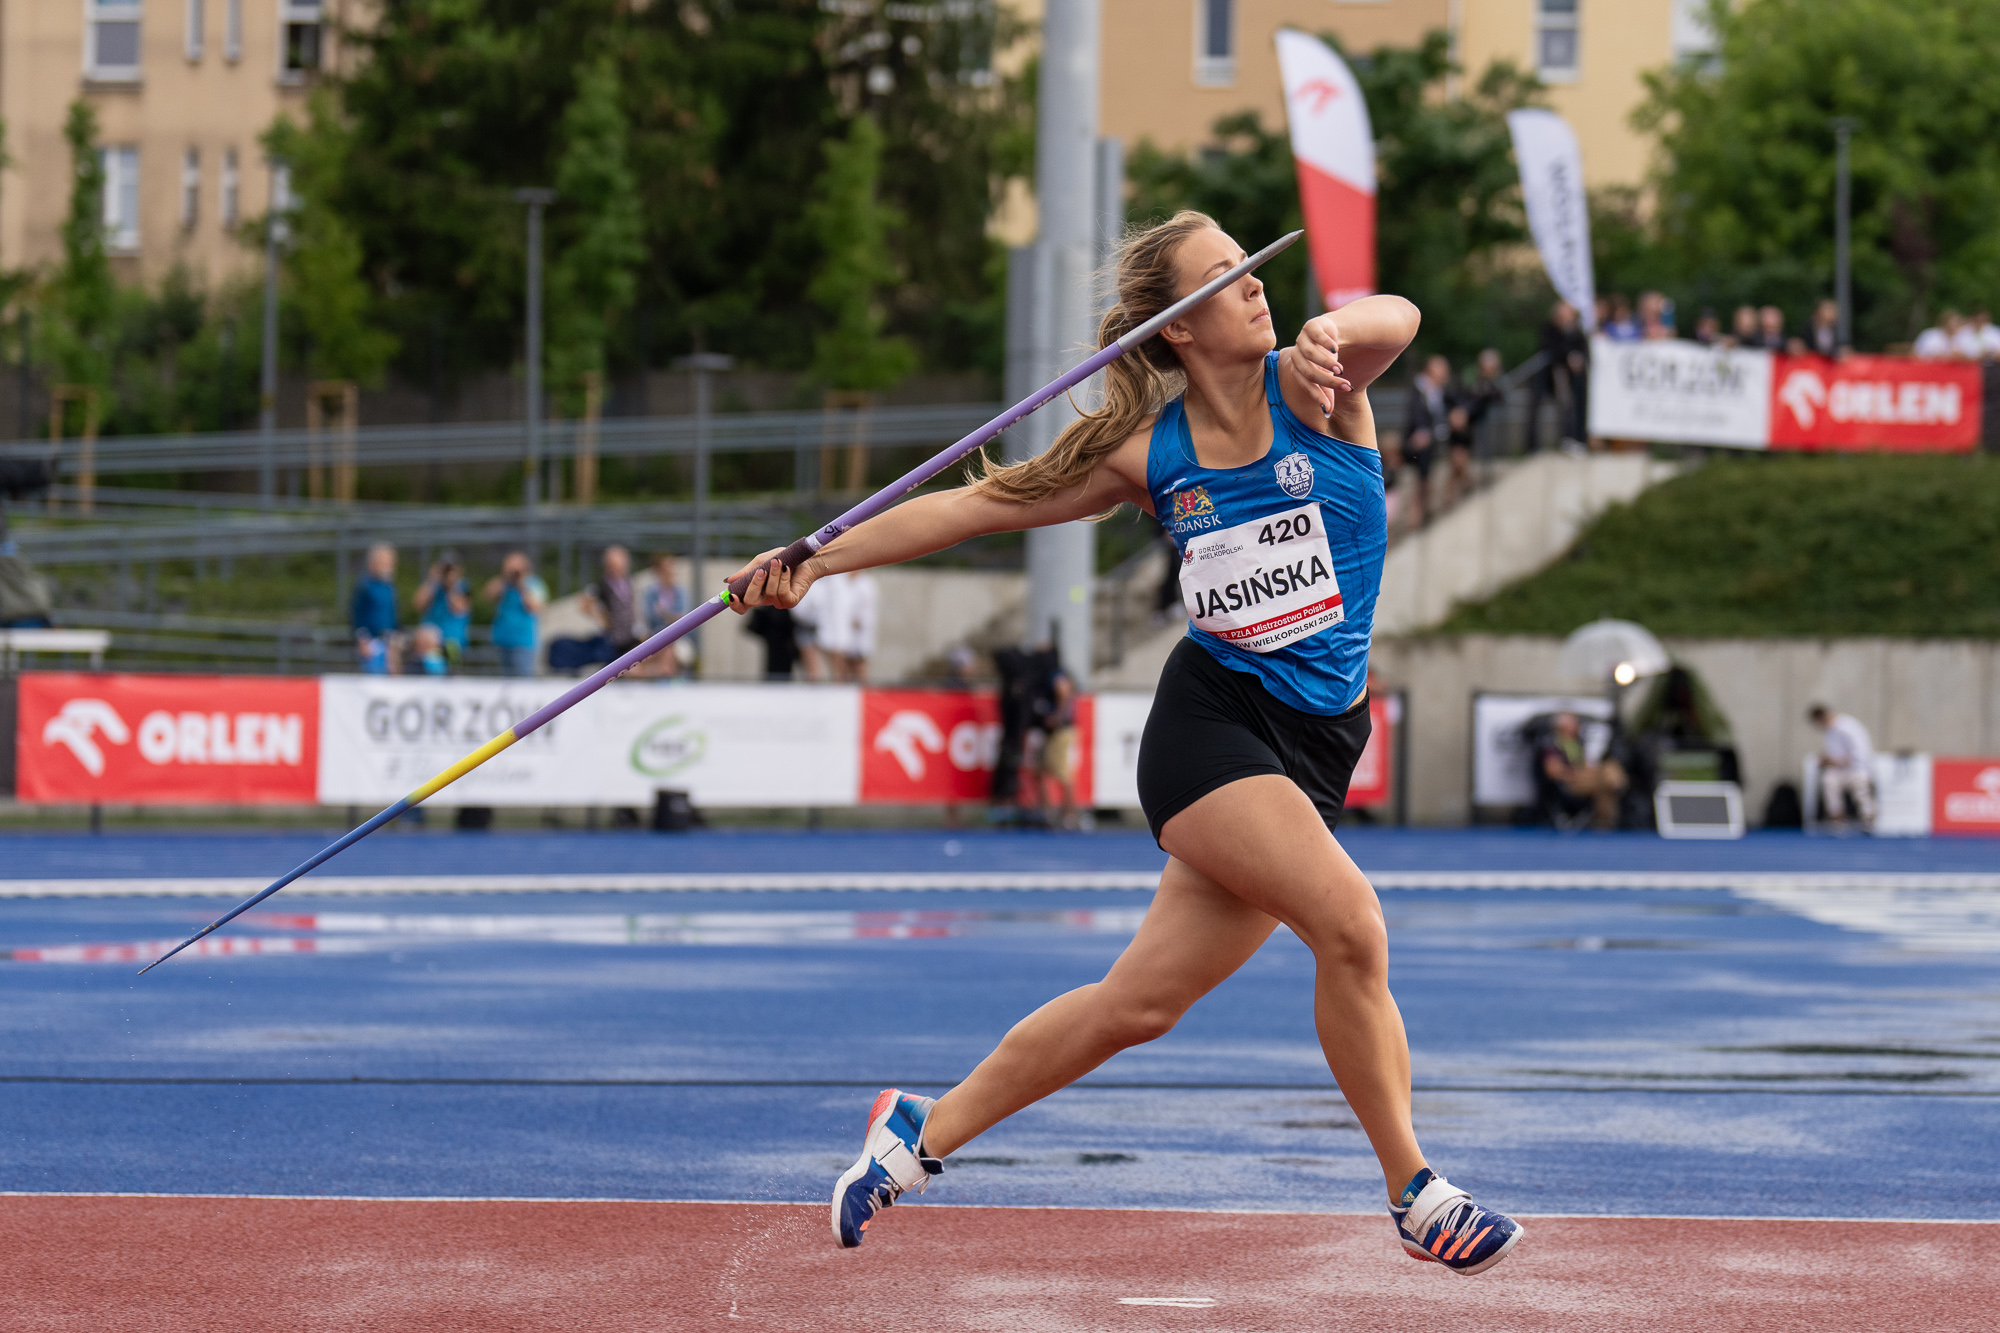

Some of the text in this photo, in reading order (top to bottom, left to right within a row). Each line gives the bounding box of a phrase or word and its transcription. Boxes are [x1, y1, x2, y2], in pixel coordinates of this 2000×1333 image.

[1828, 379, 1962, 424] ORLEN
[1285, 471, 1310, 487] AZS
[1174, 514, 1222, 533] GDAŃSK
[1258, 513, 1311, 546] 420
[1198, 543, 1226, 554] GORZÓW
[1199, 545, 1244, 560] WIELKOPOLSKI
[1195, 555, 1330, 619] JASIŃSKA
[1231, 630, 1251, 639] PZLA
[1252, 613, 1303, 634] Mistrzostwa
[1303, 602, 1326, 617] Polski
[1252, 620, 1318, 648] WIELKOPOLSKI
[1318, 611, 1339, 625] 2023
[137, 709, 301, 767] ORLEN
